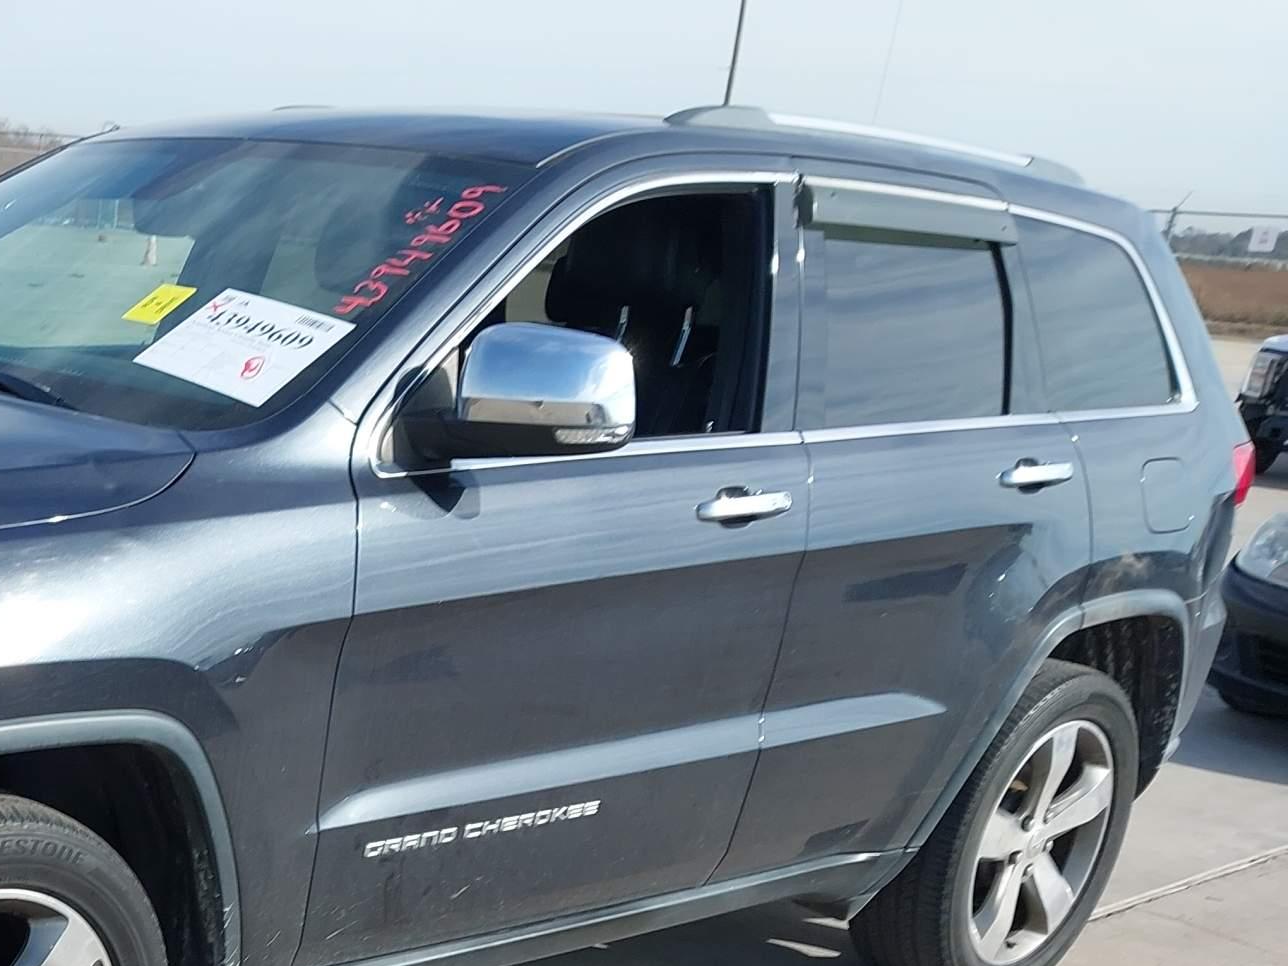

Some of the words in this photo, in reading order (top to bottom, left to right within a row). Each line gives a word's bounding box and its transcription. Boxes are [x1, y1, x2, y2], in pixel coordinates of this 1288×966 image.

[334, 184, 508, 314] 43949609
[207, 309, 314, 350] 43949609
[363, 826, 458, 858] GRAND
[463, 799, 601, 839] CHEROKEE
